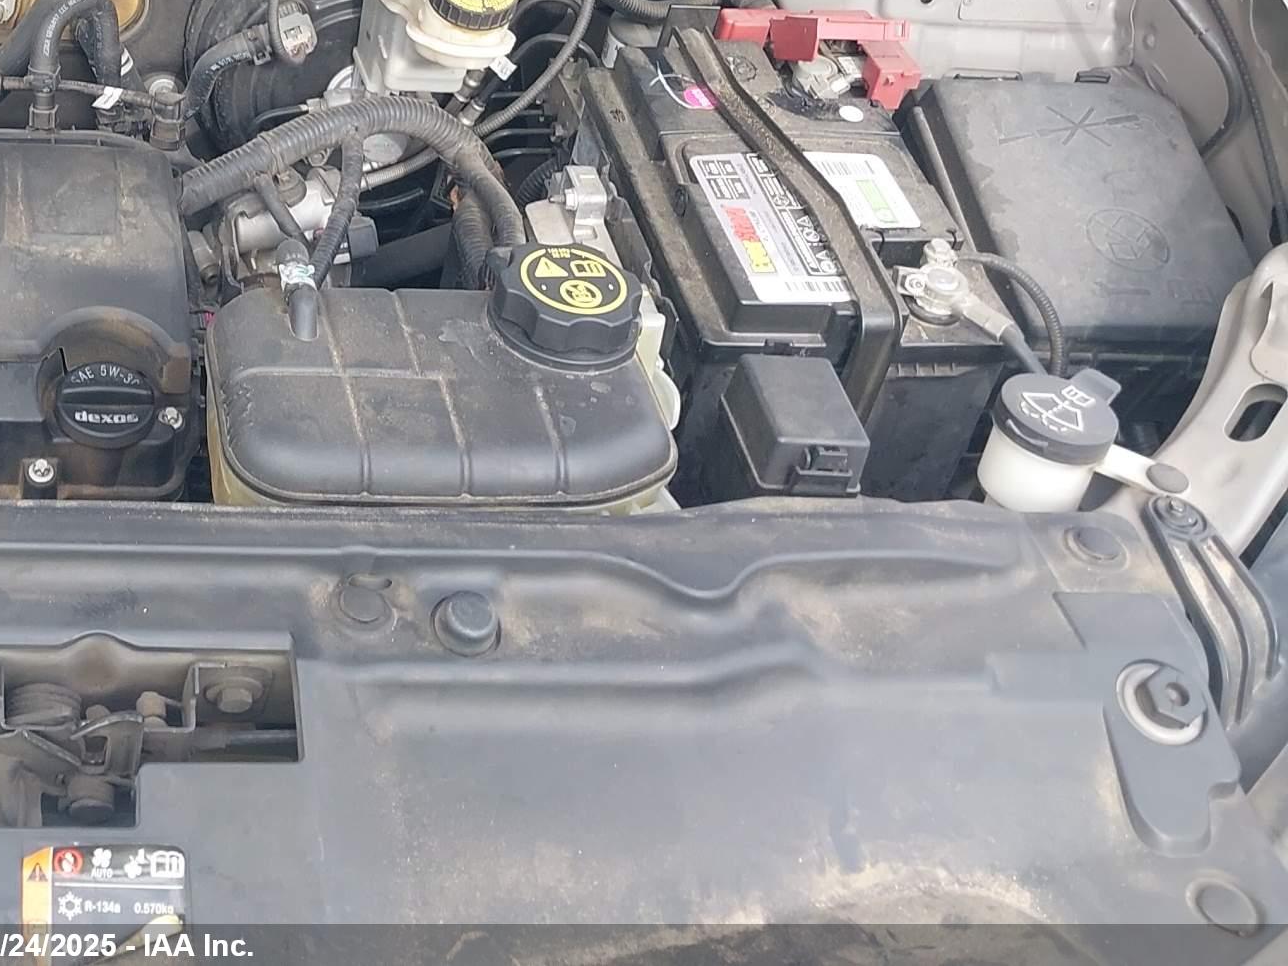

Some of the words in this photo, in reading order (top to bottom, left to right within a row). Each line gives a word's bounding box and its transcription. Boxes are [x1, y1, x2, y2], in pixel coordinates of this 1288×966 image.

[70, 366, 95, 384] SAE
[74, 410, 139, 424] dexos
[90, 868, 113, 879] AUTO
[84, 899, 121, 914] R-134a
